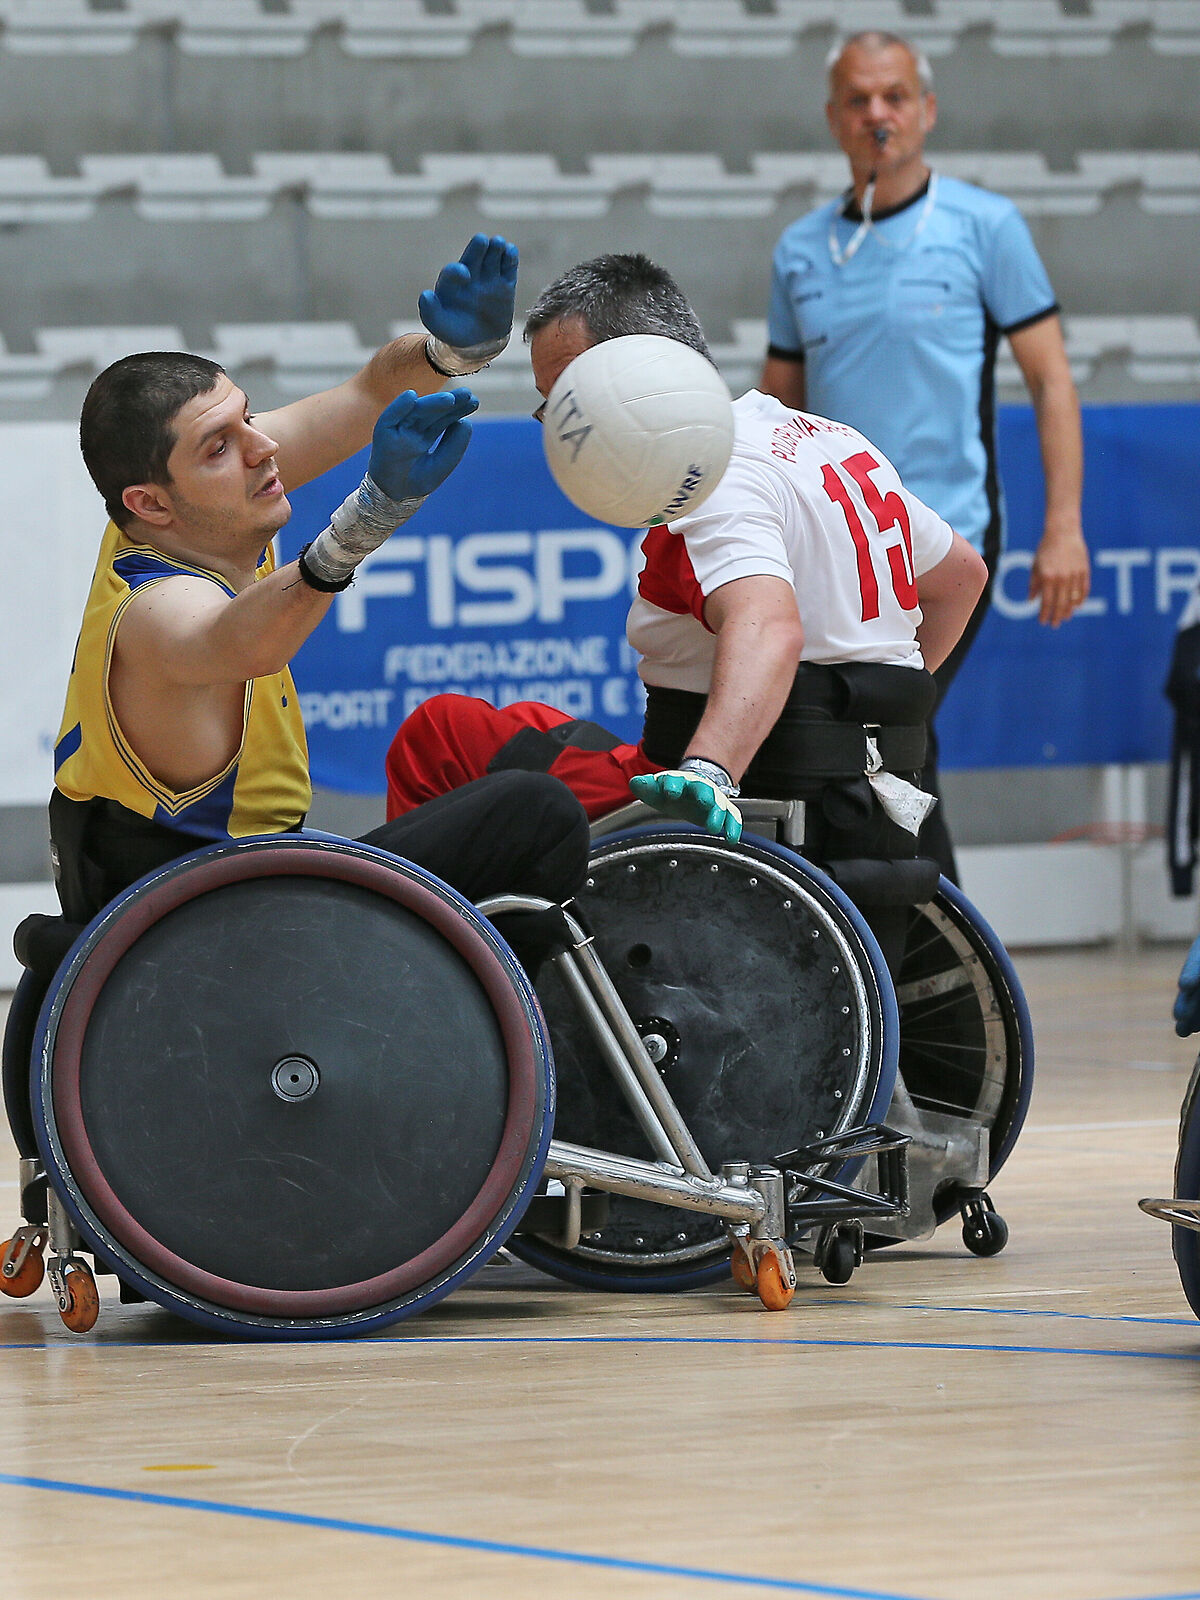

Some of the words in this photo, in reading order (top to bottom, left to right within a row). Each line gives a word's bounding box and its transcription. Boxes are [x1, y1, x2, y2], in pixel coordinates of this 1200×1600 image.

[552, 389, 594, 463] ITA
[663, 463, 705, 515] IWRF
[820, 450, 918, 622] 15
[337, 528, 648, 634] FISP
[385, 634, 609, 684] FEDERAZIONE
[299, 688, 395, 731] PORT
